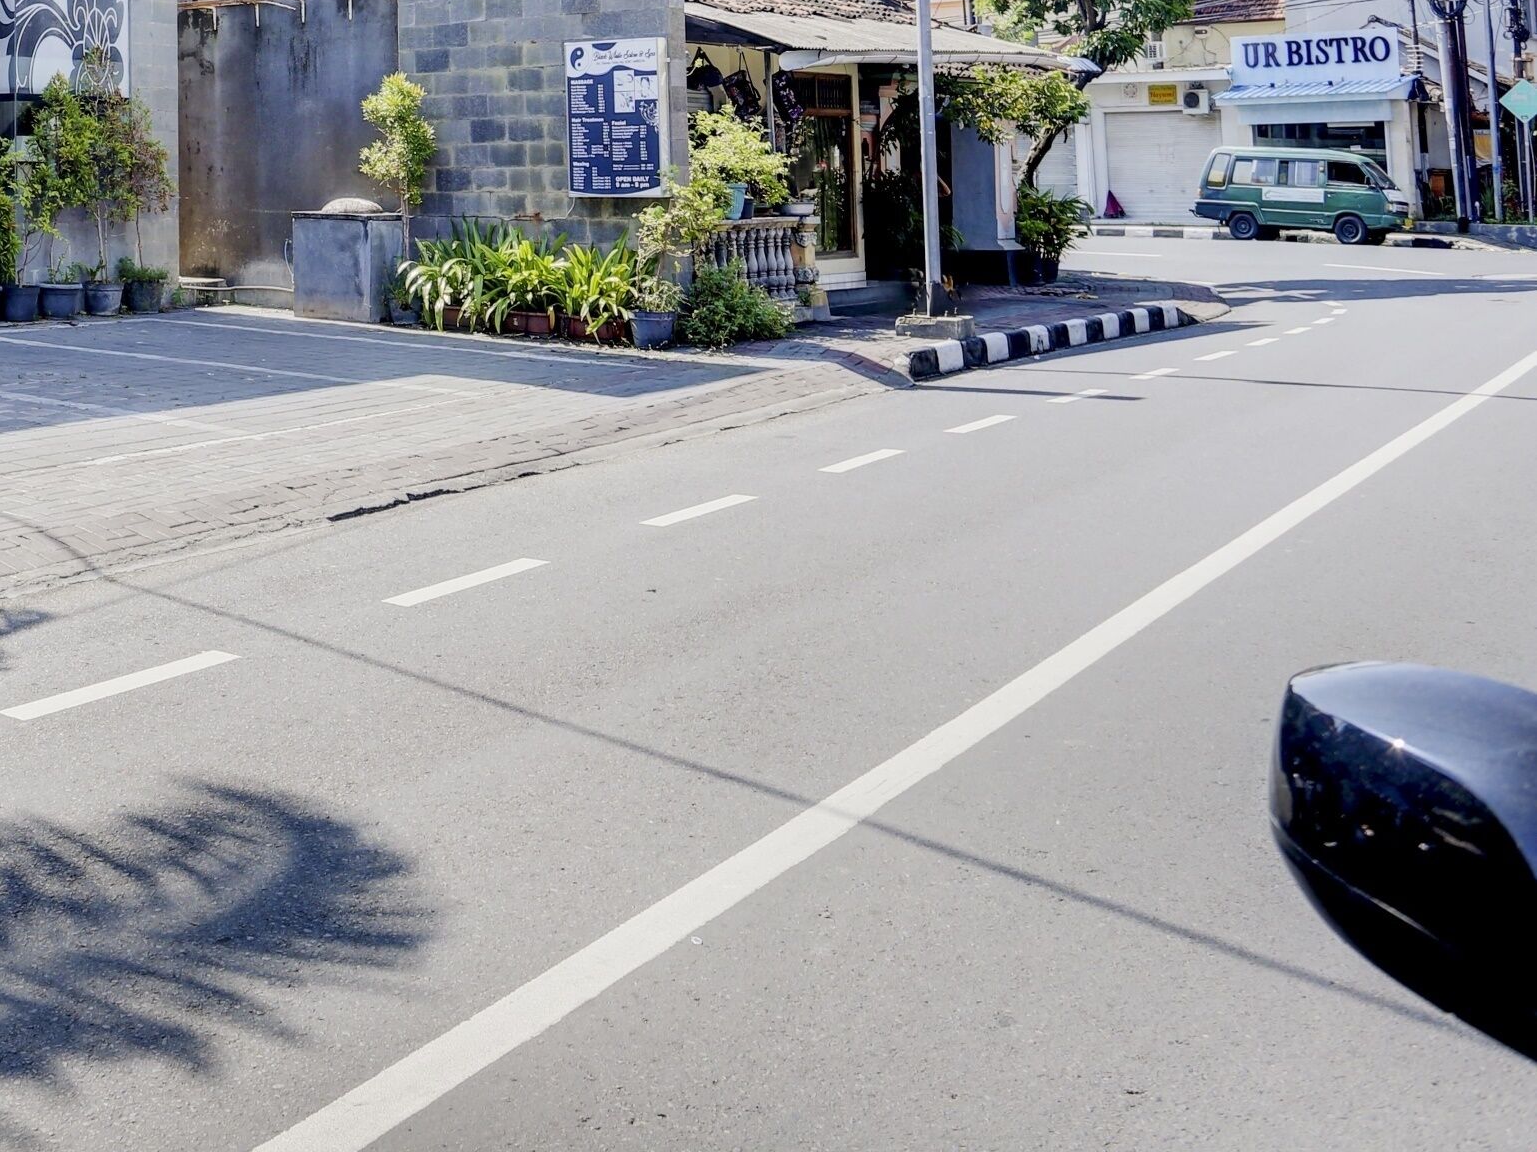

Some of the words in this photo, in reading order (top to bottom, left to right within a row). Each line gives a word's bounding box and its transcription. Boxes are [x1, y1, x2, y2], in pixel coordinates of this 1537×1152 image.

[1242, 42, 1282, 69] UR
[1285, 35, 1391, 67] BISTRO
[632, 175, 650, 183] DAILY
